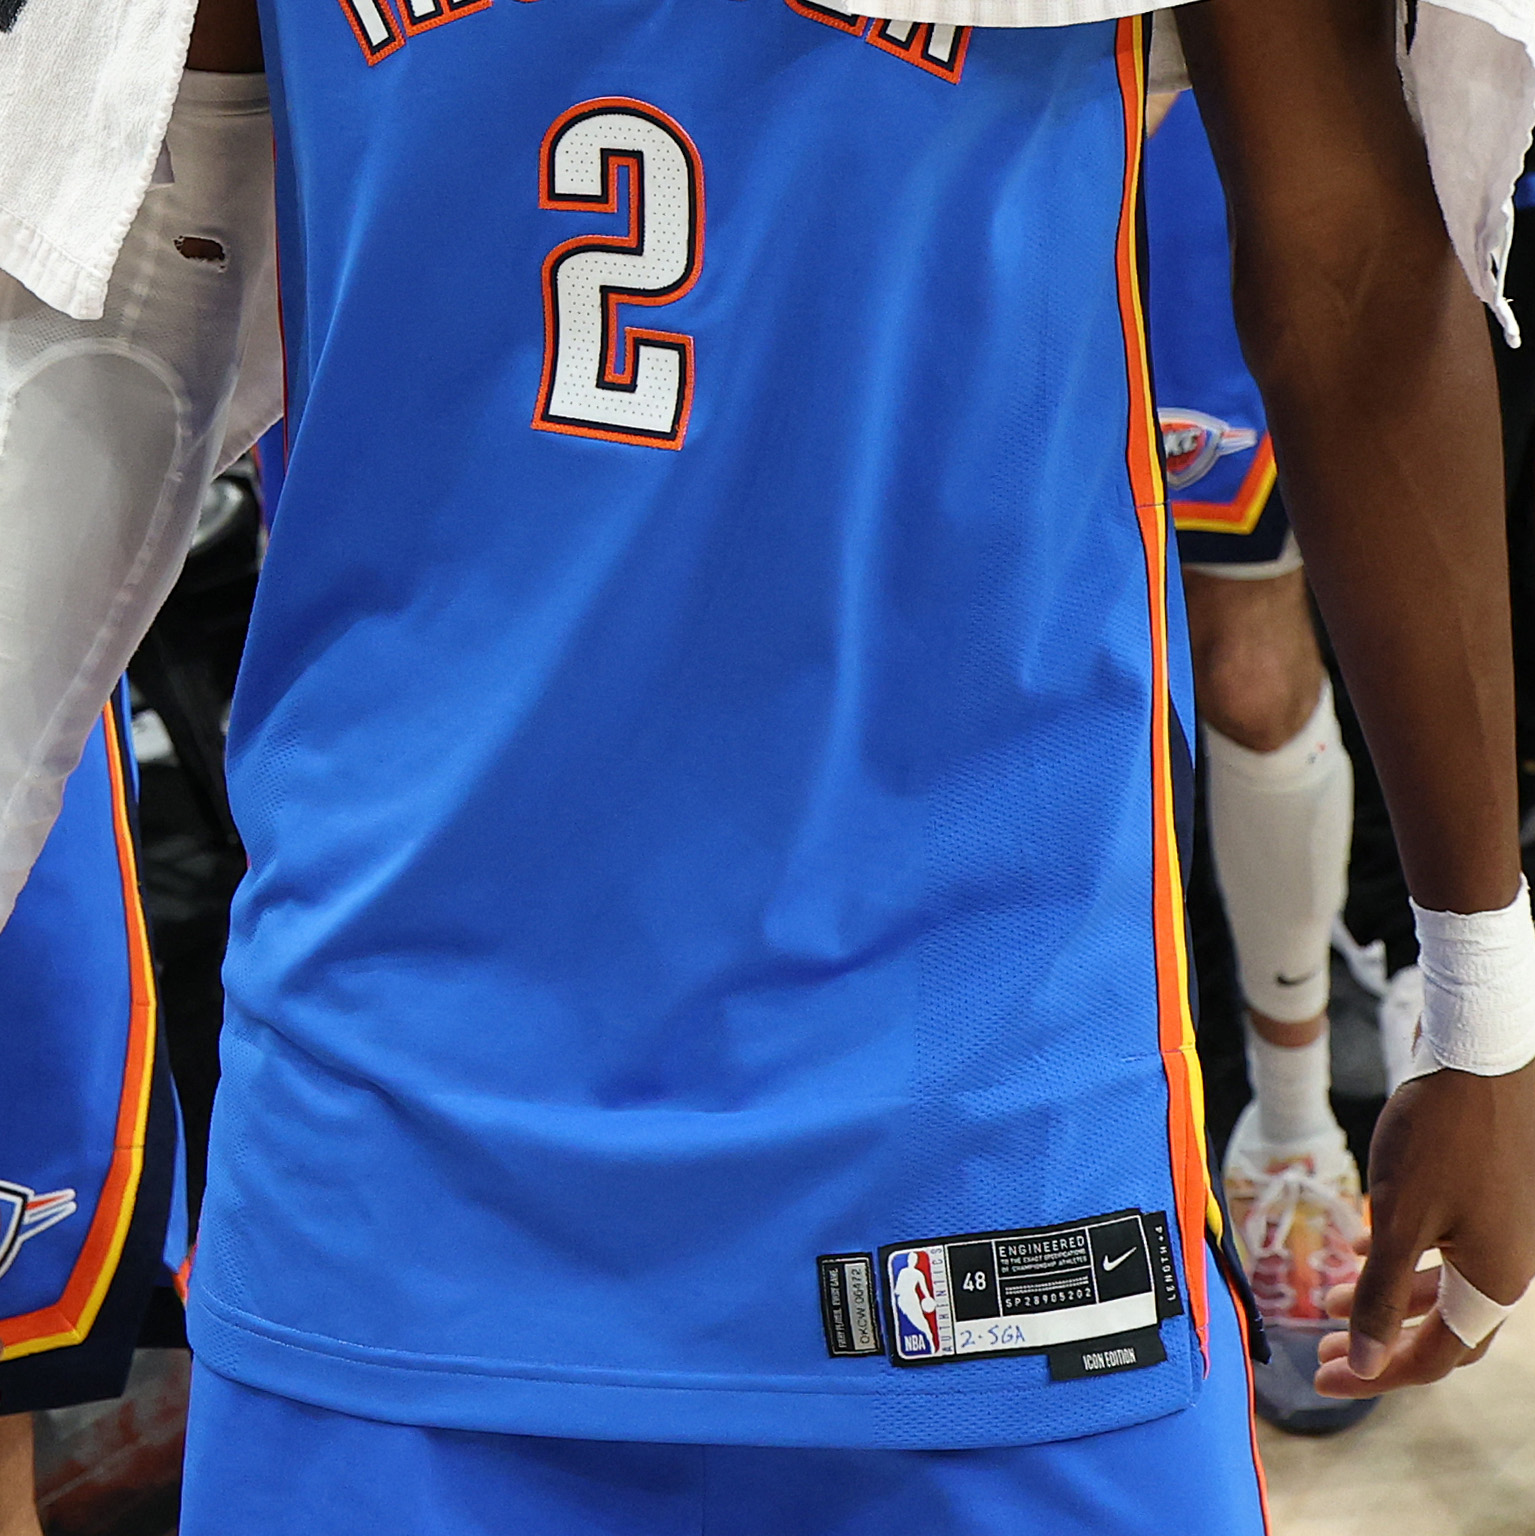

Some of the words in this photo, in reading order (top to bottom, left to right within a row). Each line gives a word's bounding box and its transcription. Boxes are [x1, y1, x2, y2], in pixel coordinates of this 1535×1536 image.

[531, 96, 705, 451] 2
[998, 1236, 1086, 1258] ENGINEERED
[962, 1271, 987, 1292] 48
[930, 1247, 953, 1353] AUTHENTICS
[904, 1333, 926, 1352] NBA
[1082, 1352, 1106, 1371] ICON
[1104, 1348, 1137, 1368] EDITION
